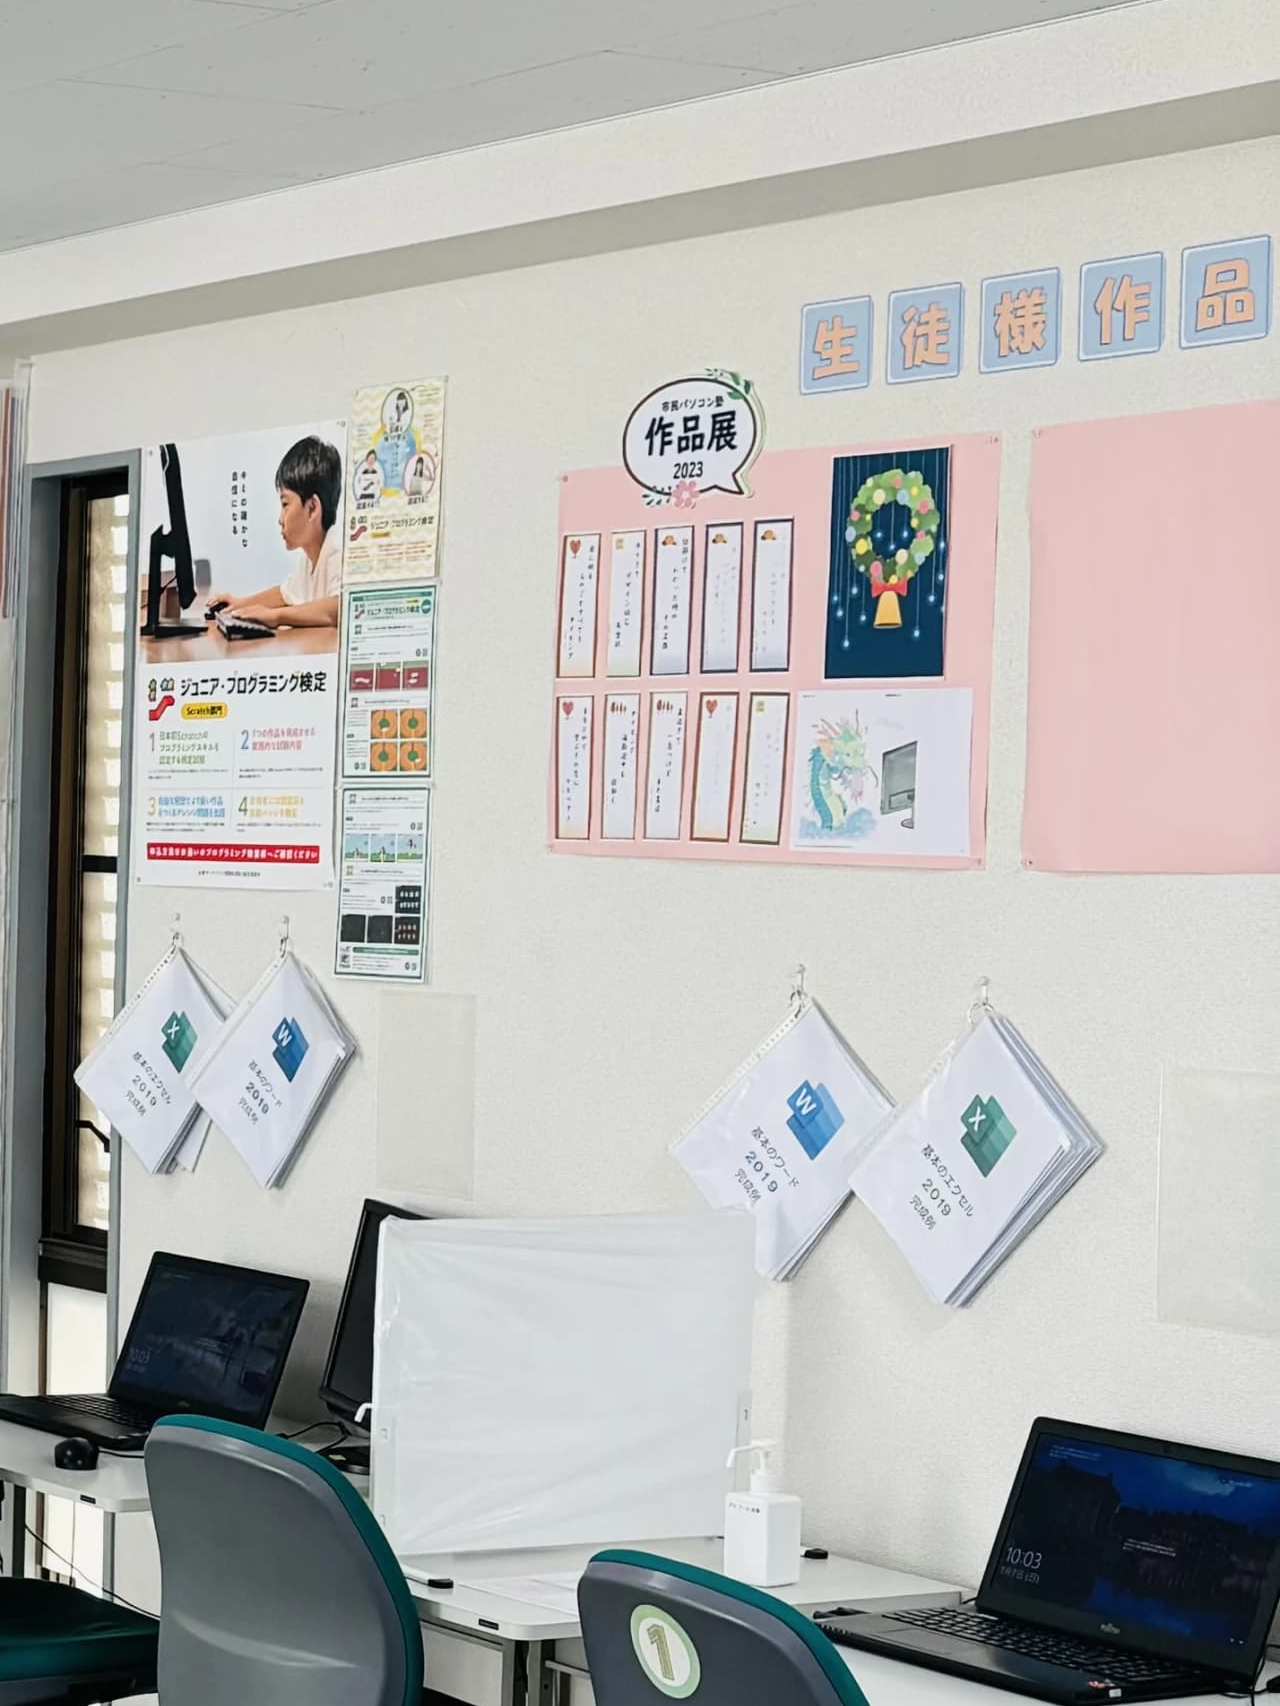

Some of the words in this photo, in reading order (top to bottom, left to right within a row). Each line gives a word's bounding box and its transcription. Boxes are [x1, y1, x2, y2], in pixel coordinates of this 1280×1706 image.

[812, 258, 1257, 381] 生徒様作品
[662, 395, 725, 412] 市民パソコン塾
[644, 410, 738, 457] 作品展
[673, 461, 704, 480] 2023
[240, 729, 250, 750] 2
[148, 796, 156, 817] 3
[238, 796, 248, 817] 4
[167, 1021, 180, 1041] X
[277, 1023, 292, 1048] W
[795, 1088, 817, 1116] W
[967, 1105, 987, 1132] X
[750, 1125, 800, 1189] 基本のワード
[920, 1143, 975, 1218] 基本のエクセル
[1005, 1546, 1043, 1570] 10:03
[646, 1623, 675, 1681] 1
